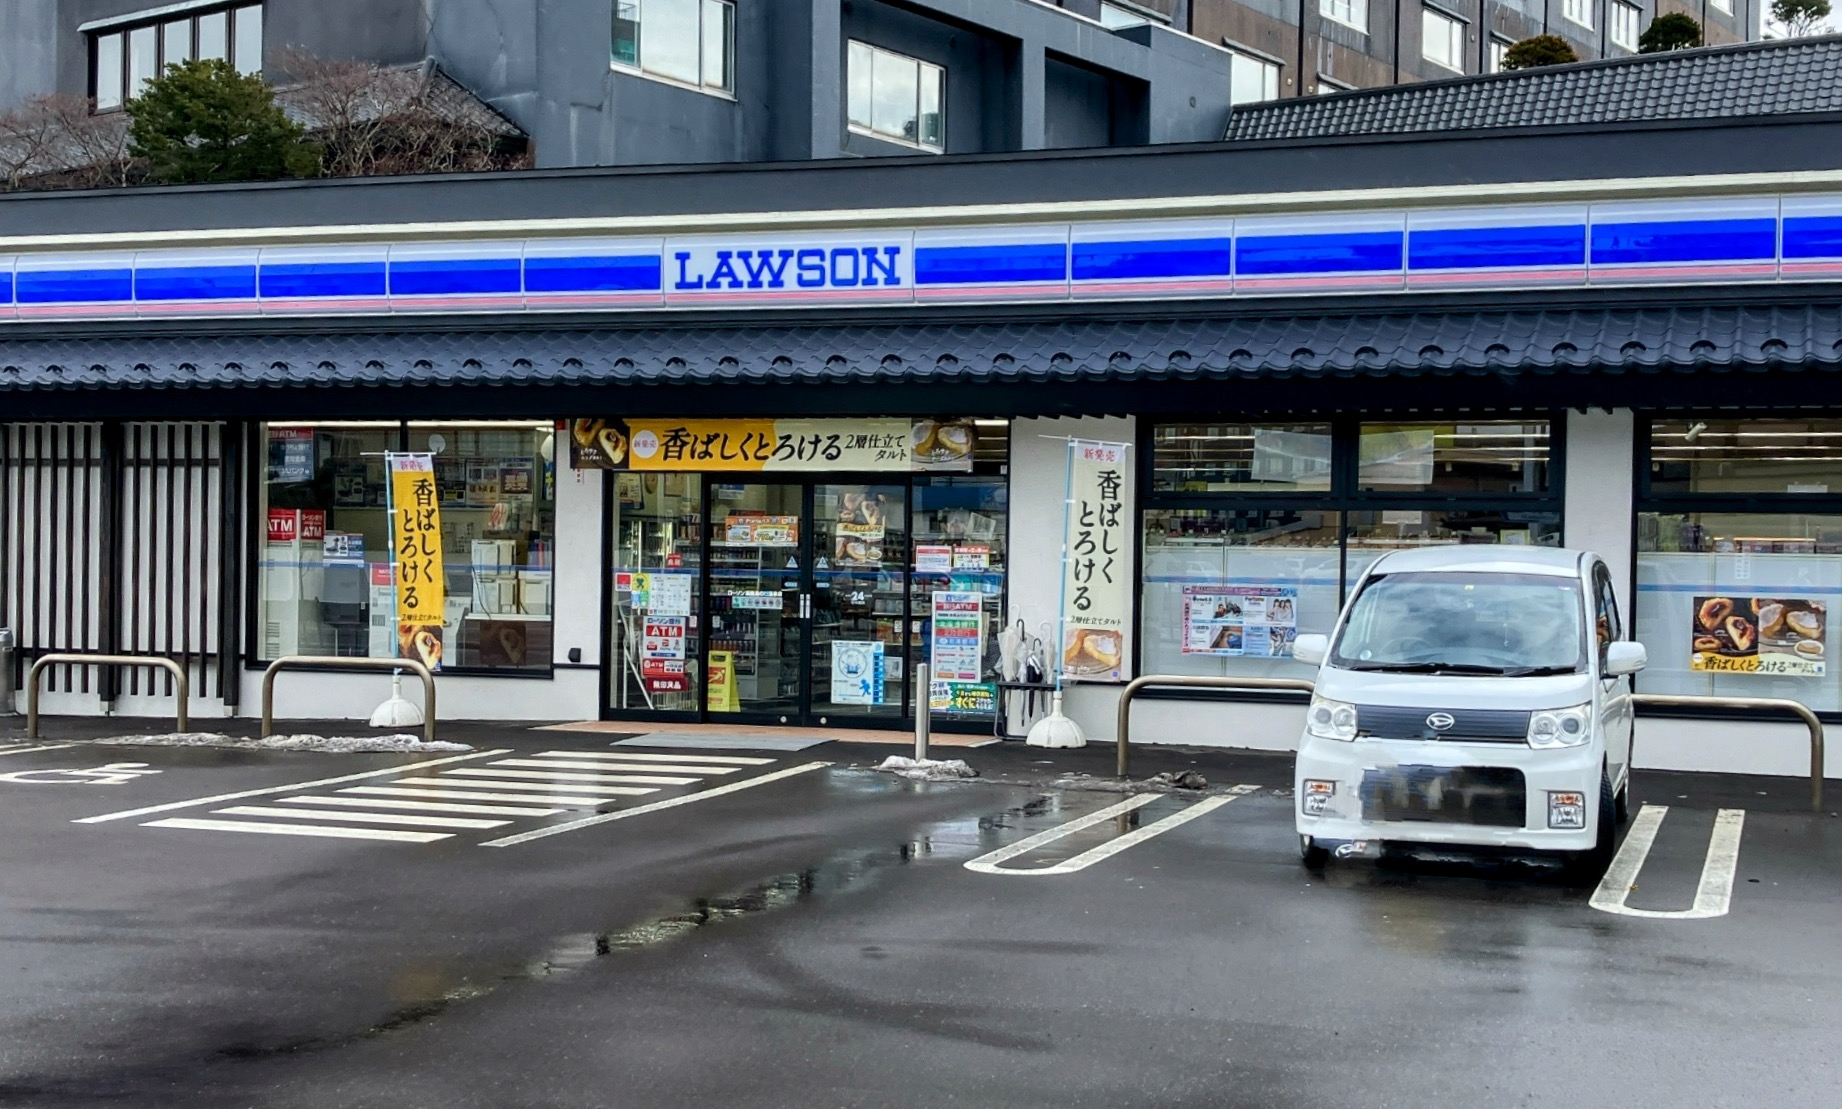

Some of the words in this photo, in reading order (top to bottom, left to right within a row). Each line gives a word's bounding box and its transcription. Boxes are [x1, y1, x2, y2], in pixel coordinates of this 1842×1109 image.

[674, 246, 901, 290] LAWSON
[660, 427, 842, 461] 香ばしくとろける
[845, 434, 906, 449] 2層仕立て
[875, 449, 907, 461] タルト
[1084, 448, 1116, 461] 新発売
[303, 526, 322, 538] ATM
[412, 478, 437, 584] 香ばしく
[1097, 469, 1122, 584] 香ばしく
[400, 508, 419, 609] とろける
[1073, 500, 1096, 611] とろける
[850, 591, 865, 600] 24
[1070, 615, 1122, 625] 2層仕立てタルト
[651, 626, 678, 636] ATM
[1703, 656, 1787, 673] 香ばしくとろける
